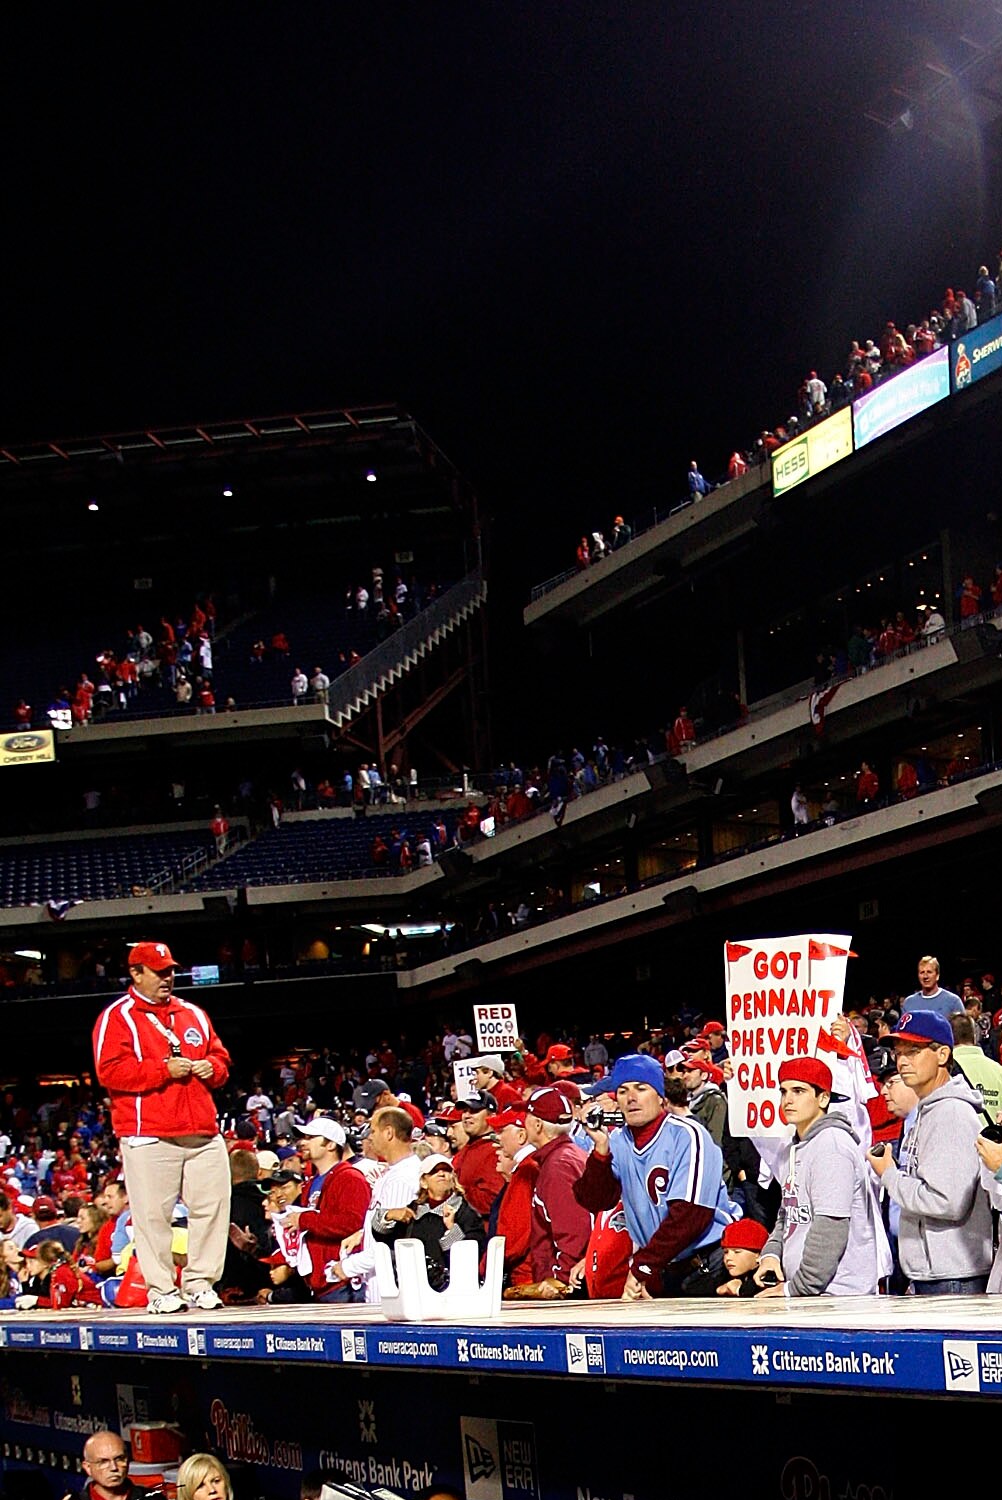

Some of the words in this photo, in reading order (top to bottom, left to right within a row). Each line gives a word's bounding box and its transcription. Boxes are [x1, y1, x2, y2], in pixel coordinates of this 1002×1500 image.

[775, 451, 806, 481] HESS
[753, 951, 802, 980] GOT
[477, 1007, 512, 1020] RED
[731, 988, 836, 1022] PENNANT
[480, 1022, 503, 1034] DOC
[481, 1036, 515, 1048] TOBER
[731, 1027, 809, 1057] PHEVER
[378, 1341, 438, 1359] neweracap.com
[470, 1342, 502, 1360] Citizens
[503, 1344, 524, 1361] Bank
[587, 1343, 602, 1354] NEW
[623, 1349, 718, 1370] neweracap.com
[588, 1354, 603, 1366] ERA
[772, 1350, 823, 1373] Citizens
[825, 1352, 860, 1374] Bank
[503, 1439, 531, 1465] NEW
[368, 1456, 402, 1489] Bank
[403, 1460, 433, 1492] Park
[505, 1465, 534, 1490] ERA
